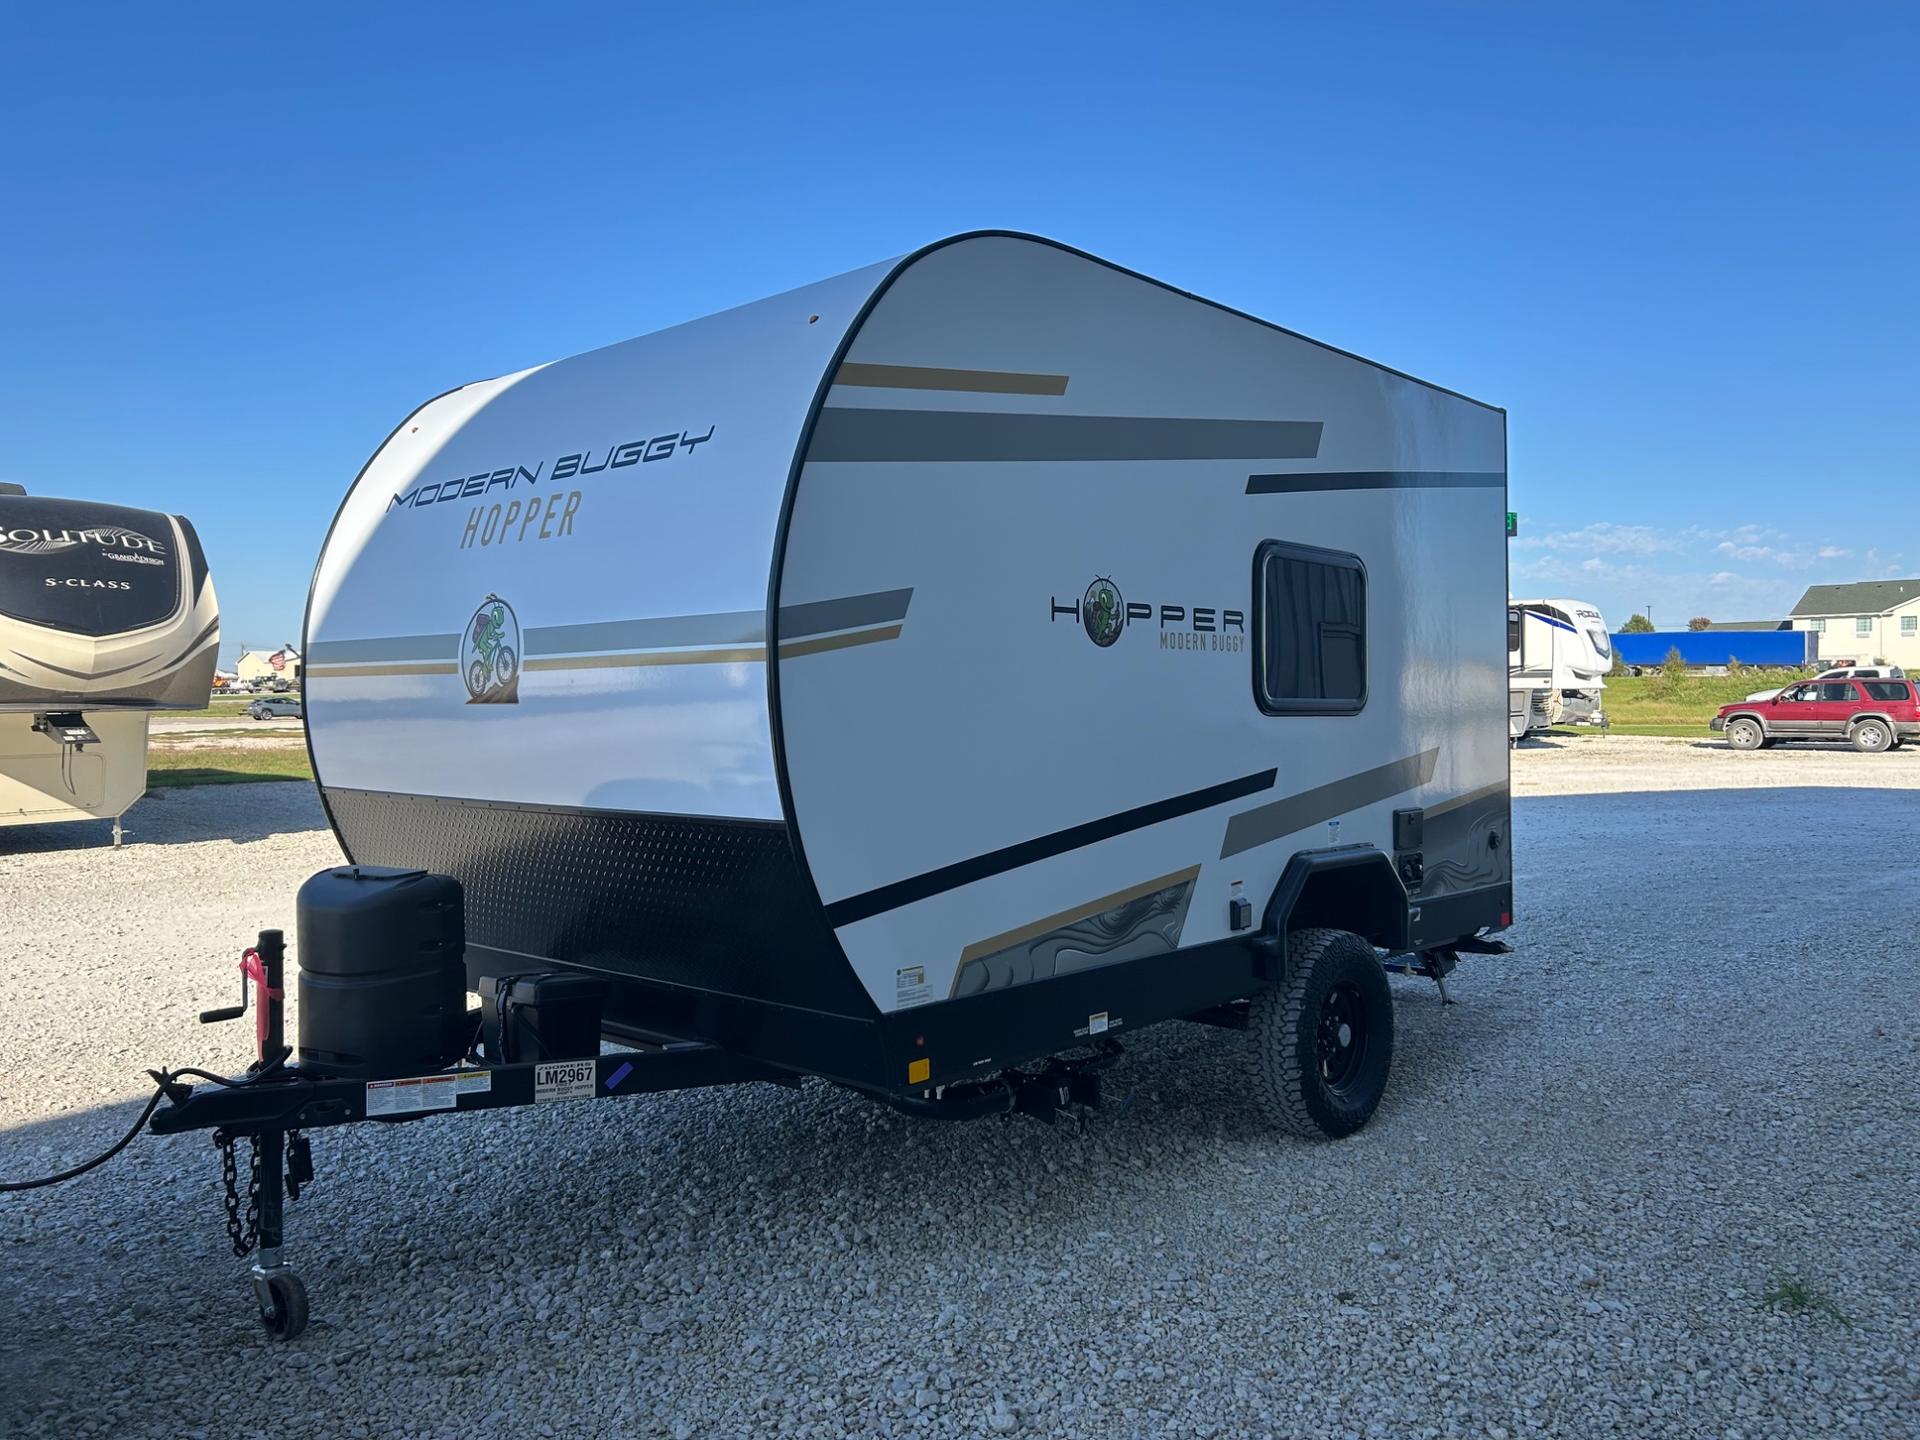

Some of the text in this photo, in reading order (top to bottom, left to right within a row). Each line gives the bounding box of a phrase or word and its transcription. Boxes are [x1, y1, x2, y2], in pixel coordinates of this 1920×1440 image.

[386, 425, 715, 513] MODERN BUGGY
[460, 490, 583, 549] HOPPER
[45, 577, 131, 590] S-CLASS
[1160, 632, 1245, 653] MODERN BUGGY
[537, 1067, 593, 1085] LM2967
